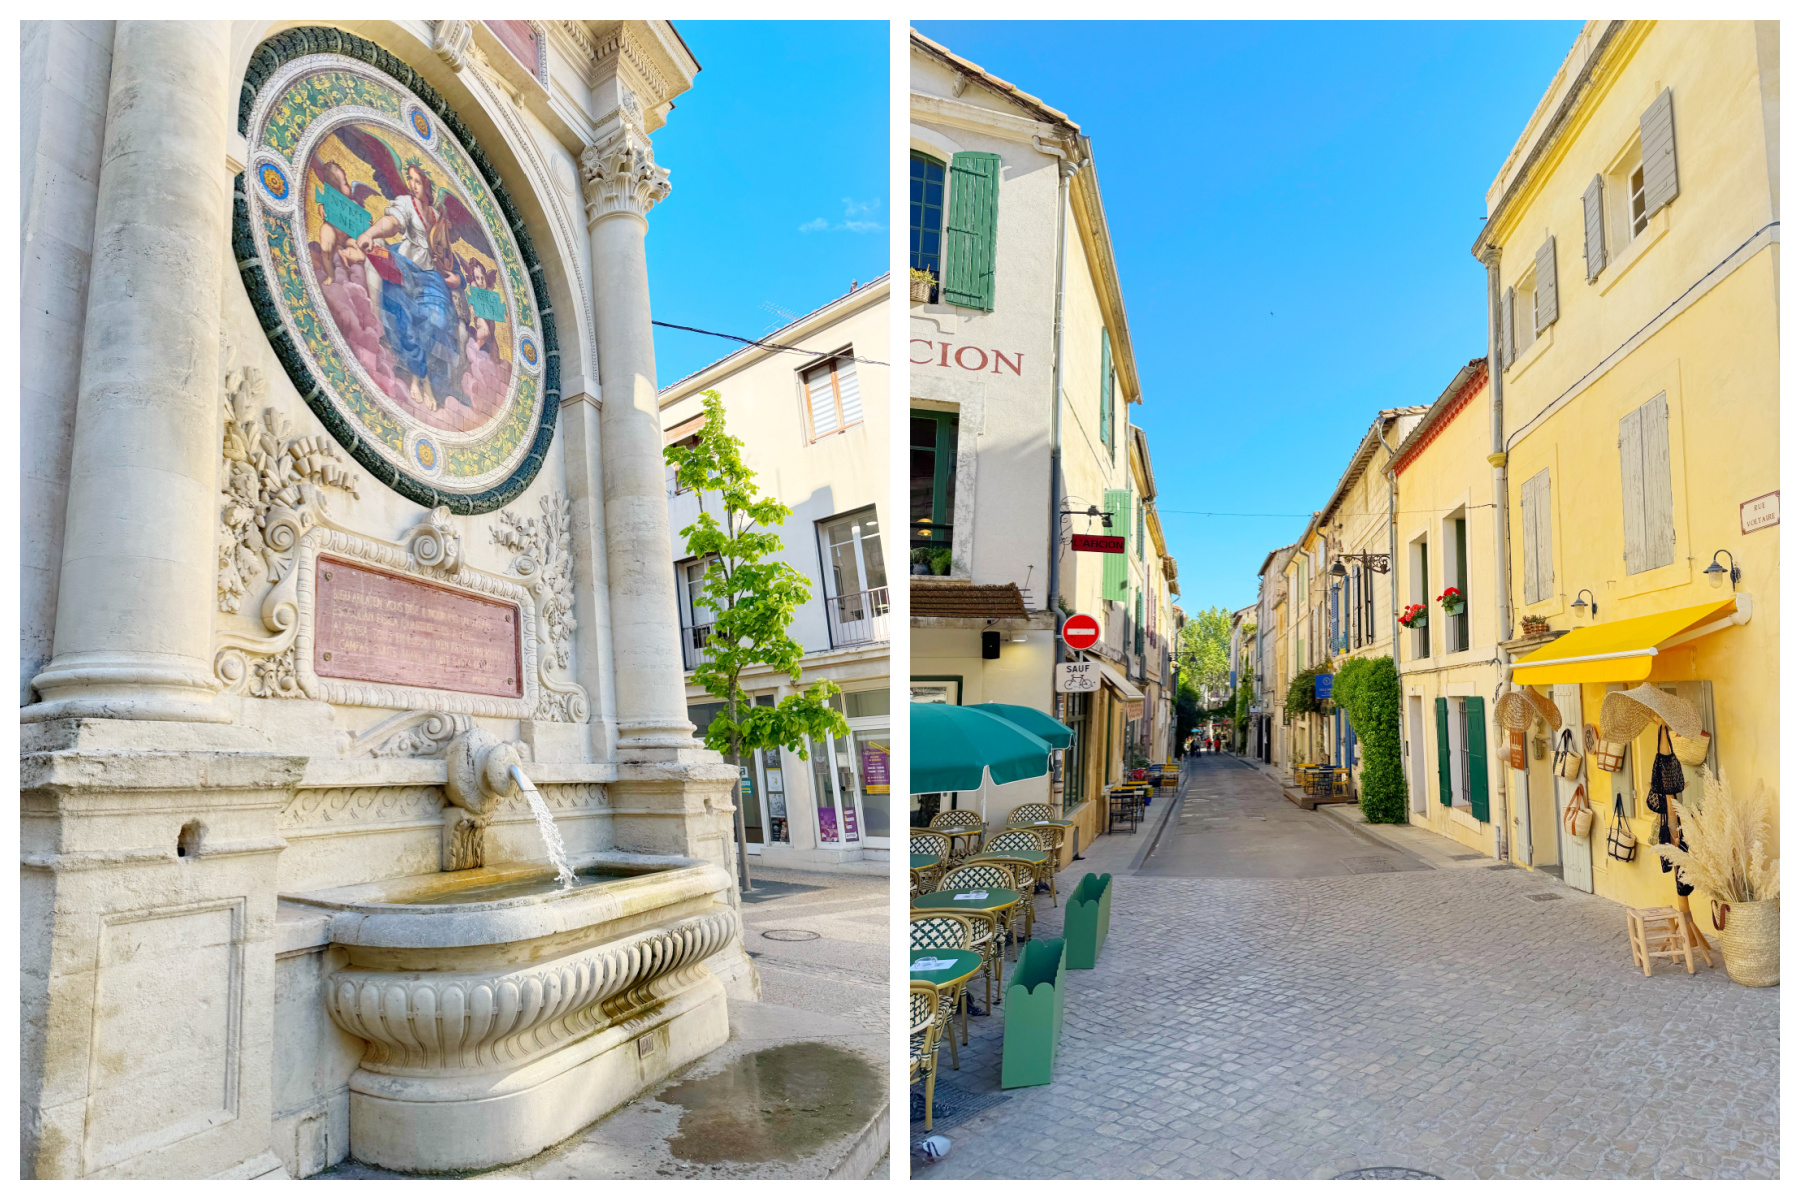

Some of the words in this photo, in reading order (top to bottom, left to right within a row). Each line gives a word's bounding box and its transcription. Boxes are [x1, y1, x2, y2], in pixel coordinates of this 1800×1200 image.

[1754, 502, 1765, 511] RUE
[1746, 512, 1775, 526] VOLTAIRE
[1073, 538, 1123, 550] L'AFICION
[1066, 664, 1091, 673] SAUF
